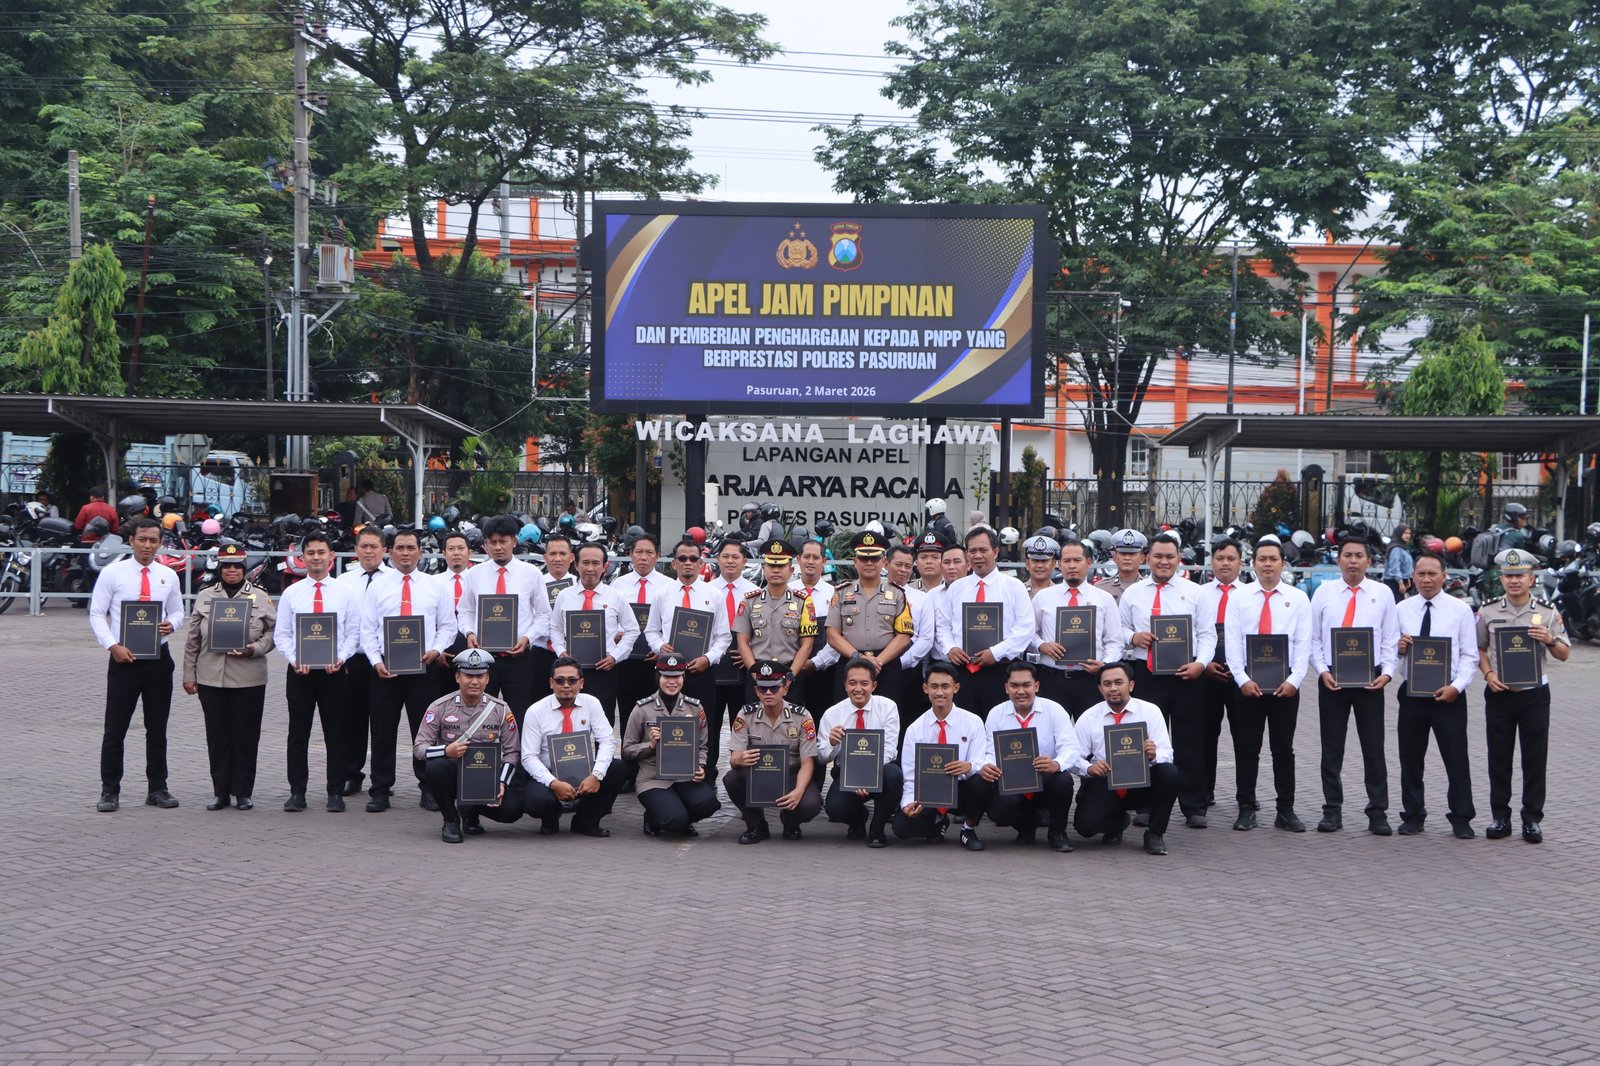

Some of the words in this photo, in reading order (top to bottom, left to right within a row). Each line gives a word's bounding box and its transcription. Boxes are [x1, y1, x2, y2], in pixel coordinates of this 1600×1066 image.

[689, 283, 751, 315] APEL
[760, 284, 814, 316] JAM
[823, 284, 953, 317] PIMPINAN
[636, 326, 666, 344] DAN
[670, 327, 750, 345] PEMBERIAN
[755, 328, 859, 346] PENGHARGAAN
[863, 329, 919, 347] KEPADA
[924, 330, 962, 348] PNPP
[967, 330, 1005, 349] YANG
[703, 349, 798, 368] BERPRESTASI
[802, 350, 855, 369] POLRES
[859, 351, 937, 370] PASURUAN
[746, 385, 802, 398] Pasuruan,
[805, 386, 812, 396] 2
[814, 386, 848, 396] Maret
[850, 386, 876, 397] 2026
[635, 420, 825, 443] WICAKSANA
[848, 423, 1000, 446] LAGHAWA
[742, 446, 852, 464] LAPANGAN
[857, 448, 910, 465] APEL
[777, 475, 847, 498] ARYA
[850, 476, 965, 499] RACAA
